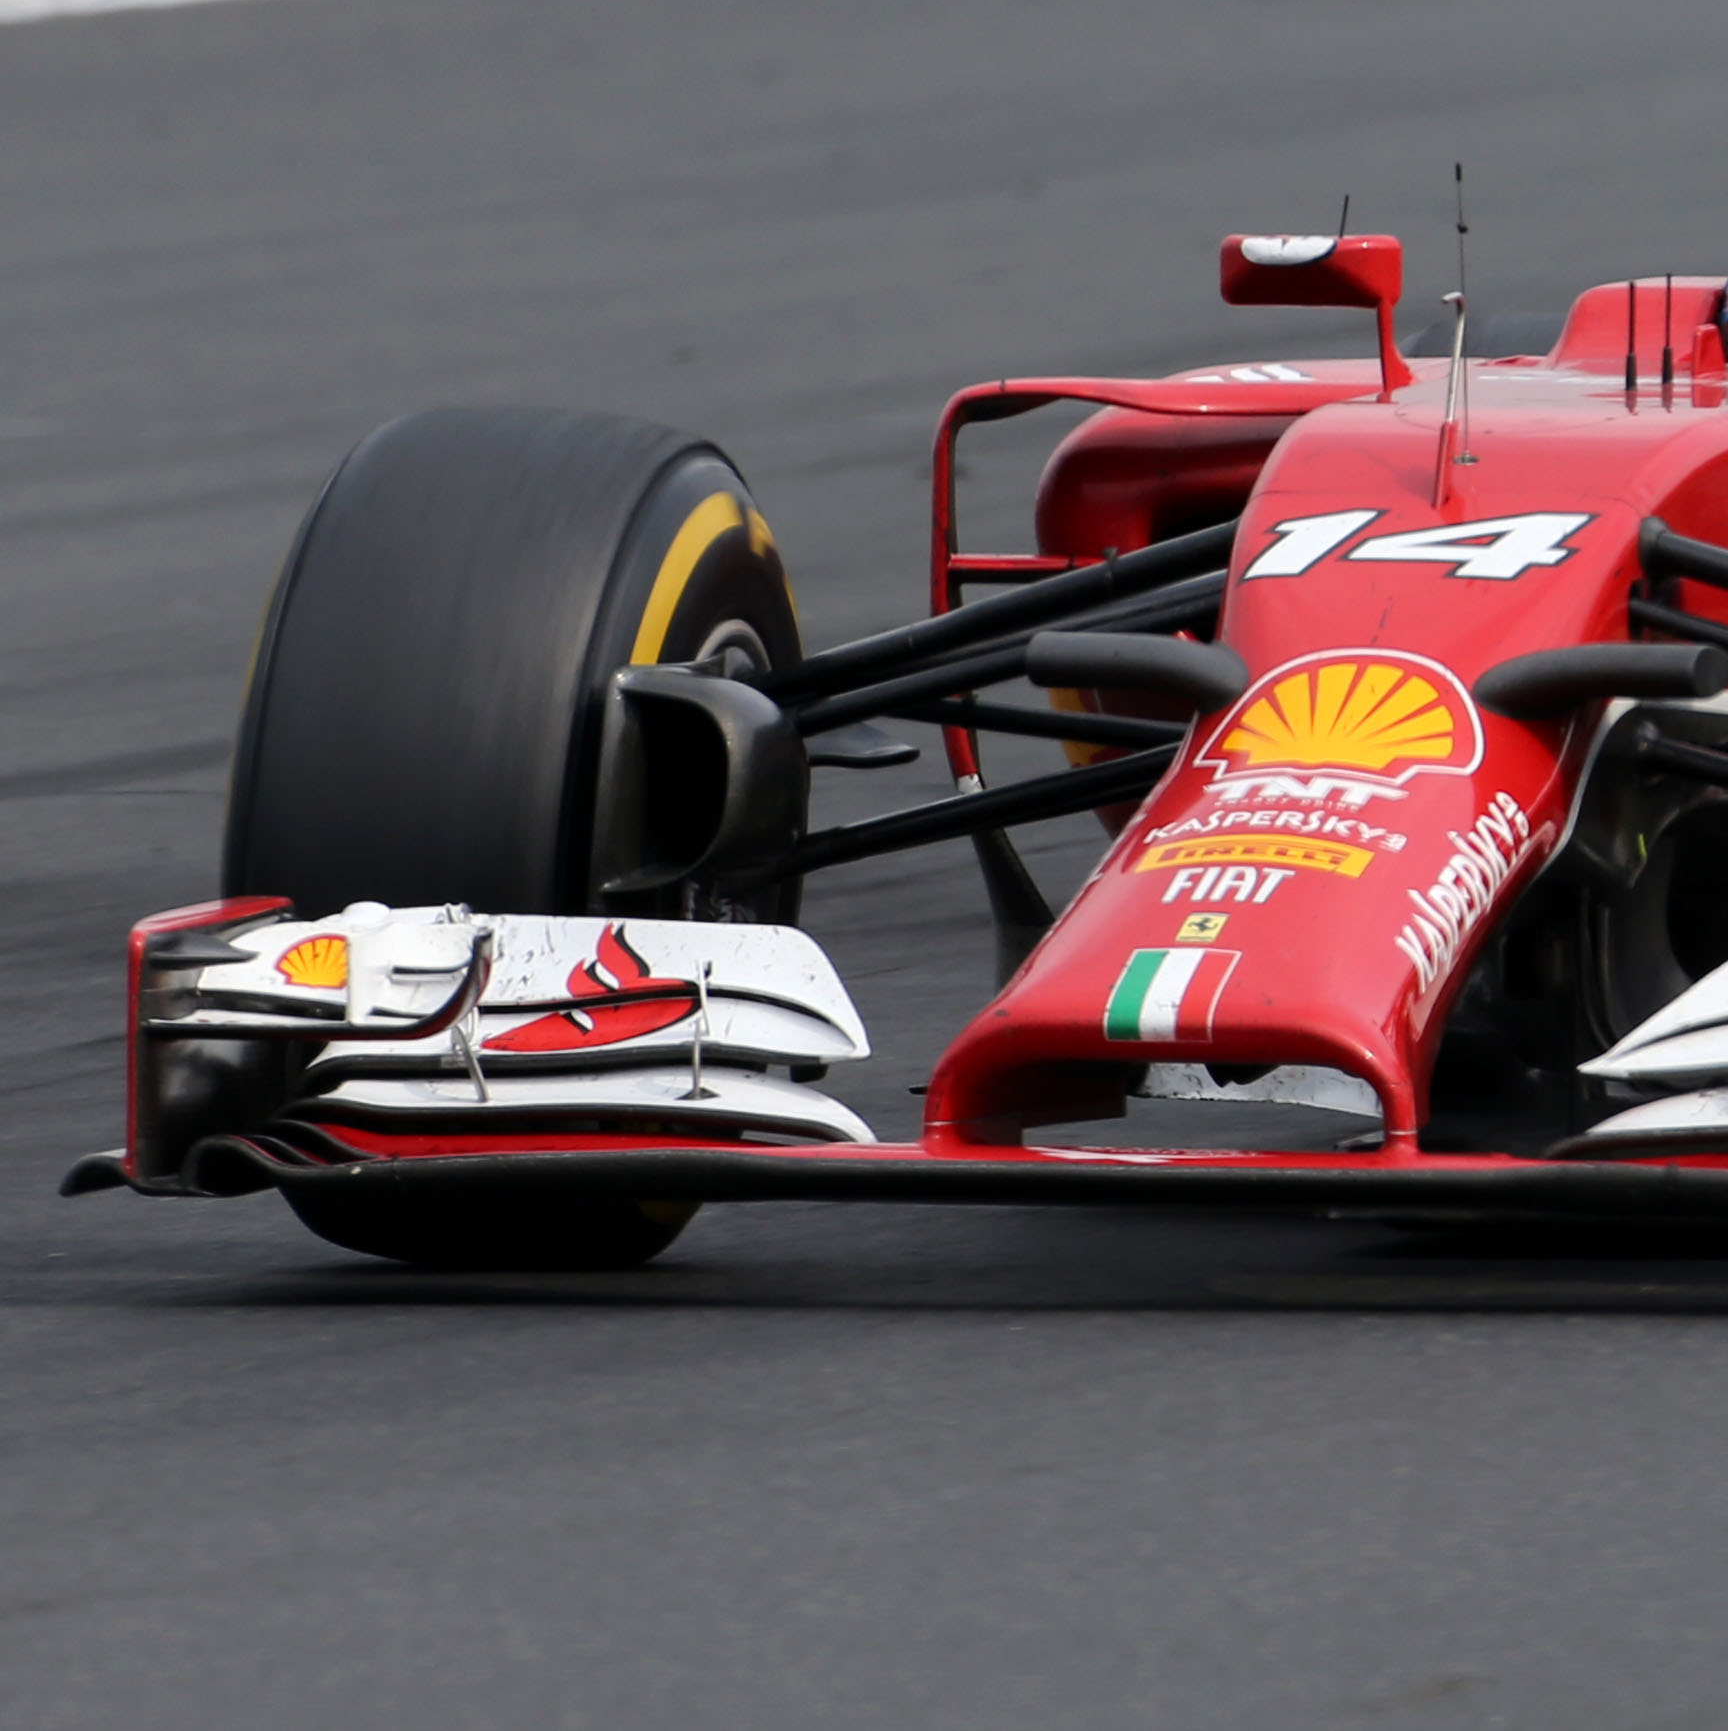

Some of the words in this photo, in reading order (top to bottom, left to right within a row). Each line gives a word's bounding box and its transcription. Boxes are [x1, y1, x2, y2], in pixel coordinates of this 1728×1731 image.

[1238, 508, 1600, 582] 14
[1202, 774, 1410, 807] TNT
[1142, 809, 1388, 845] KASPERSKY
[1160, 865, 1297, 904] FIAT
